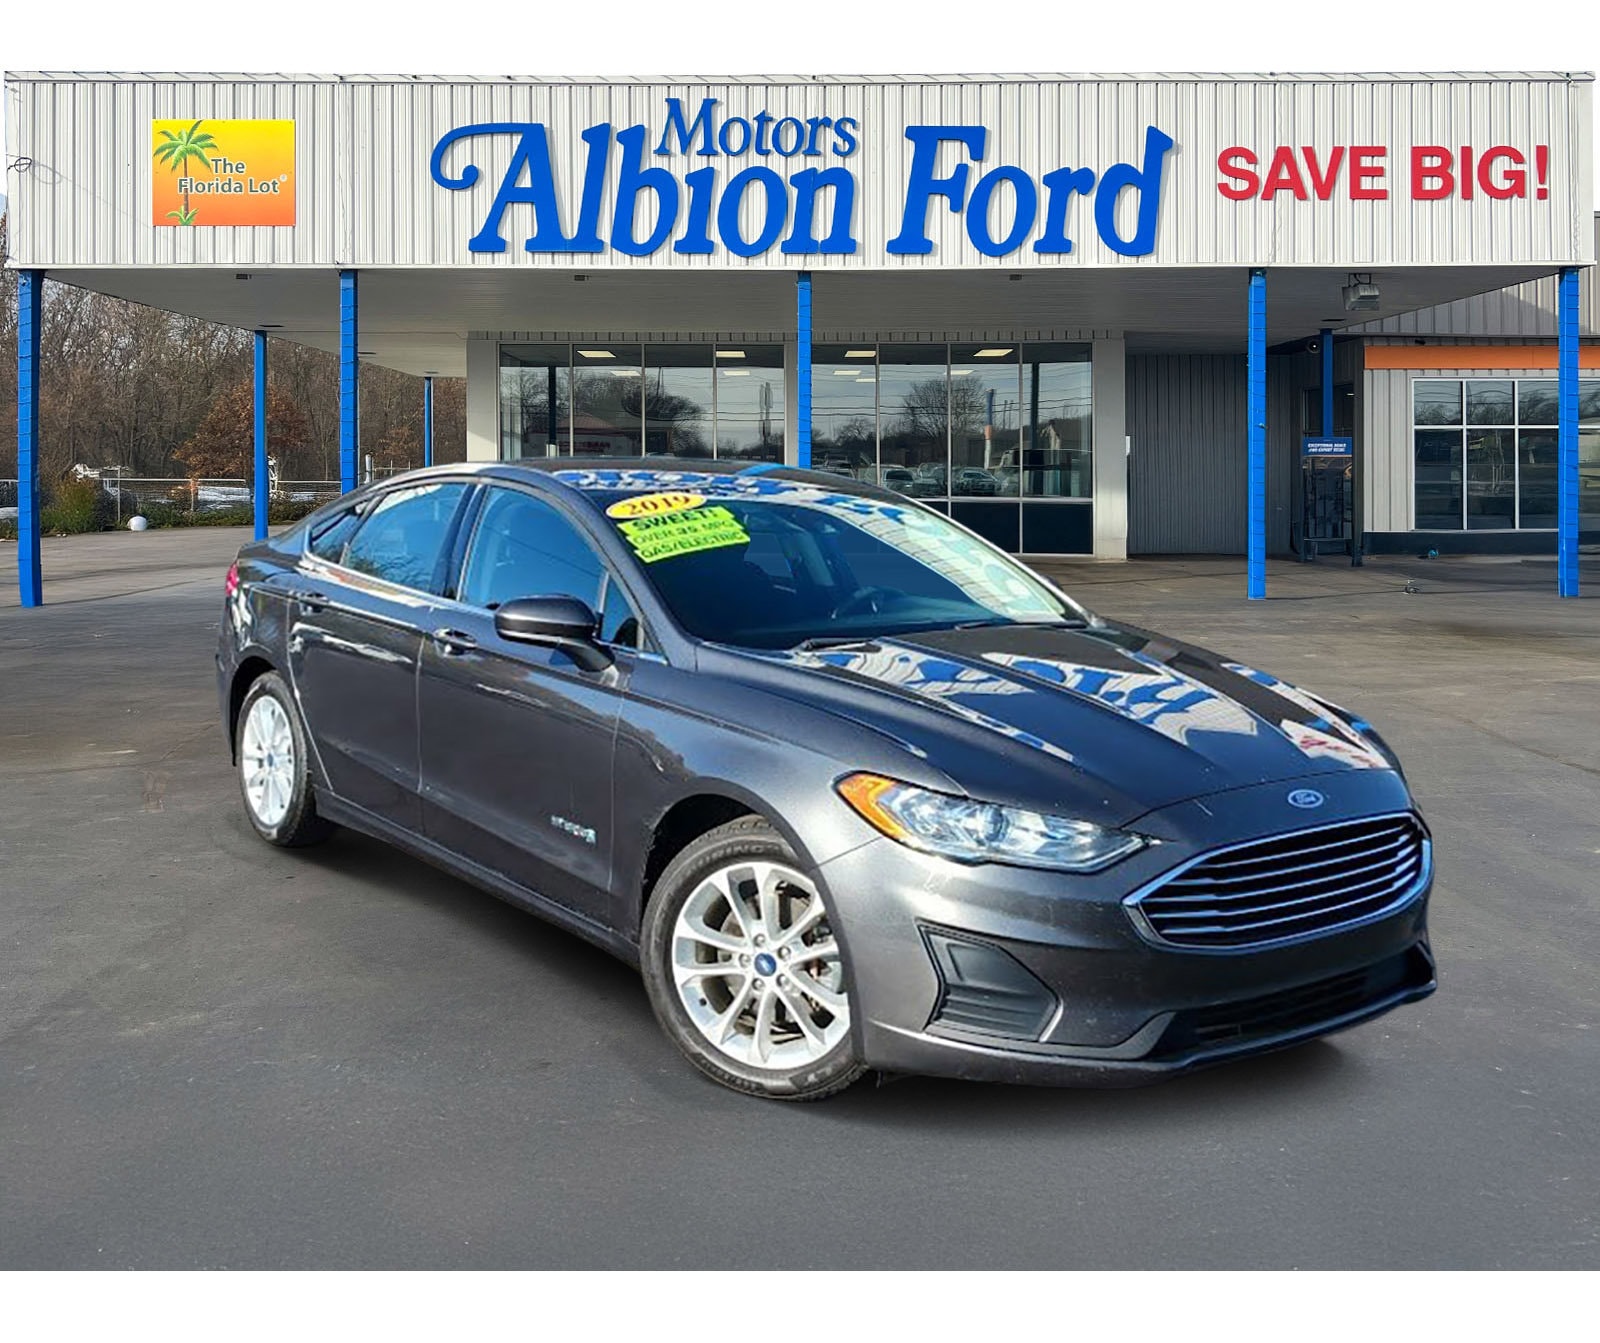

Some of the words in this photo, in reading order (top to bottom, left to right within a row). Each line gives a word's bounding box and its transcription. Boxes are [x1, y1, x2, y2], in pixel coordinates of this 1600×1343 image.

[653, 97, 857, 157] Motors
[211, 158, 246, 174] The
[1217, 146, 1388, 200] SAVE
[1410, 145, 1548, 200] BIG!
[178, 177, 243, 194] Florida
[430, 122, 857, 257] Albion
[886, 125, 1174, 257] Ford
[624, 496, 690, 515] 2019
[632, 509, 717, 530] SWEET!
[633, 529, 675, 544] OVER
